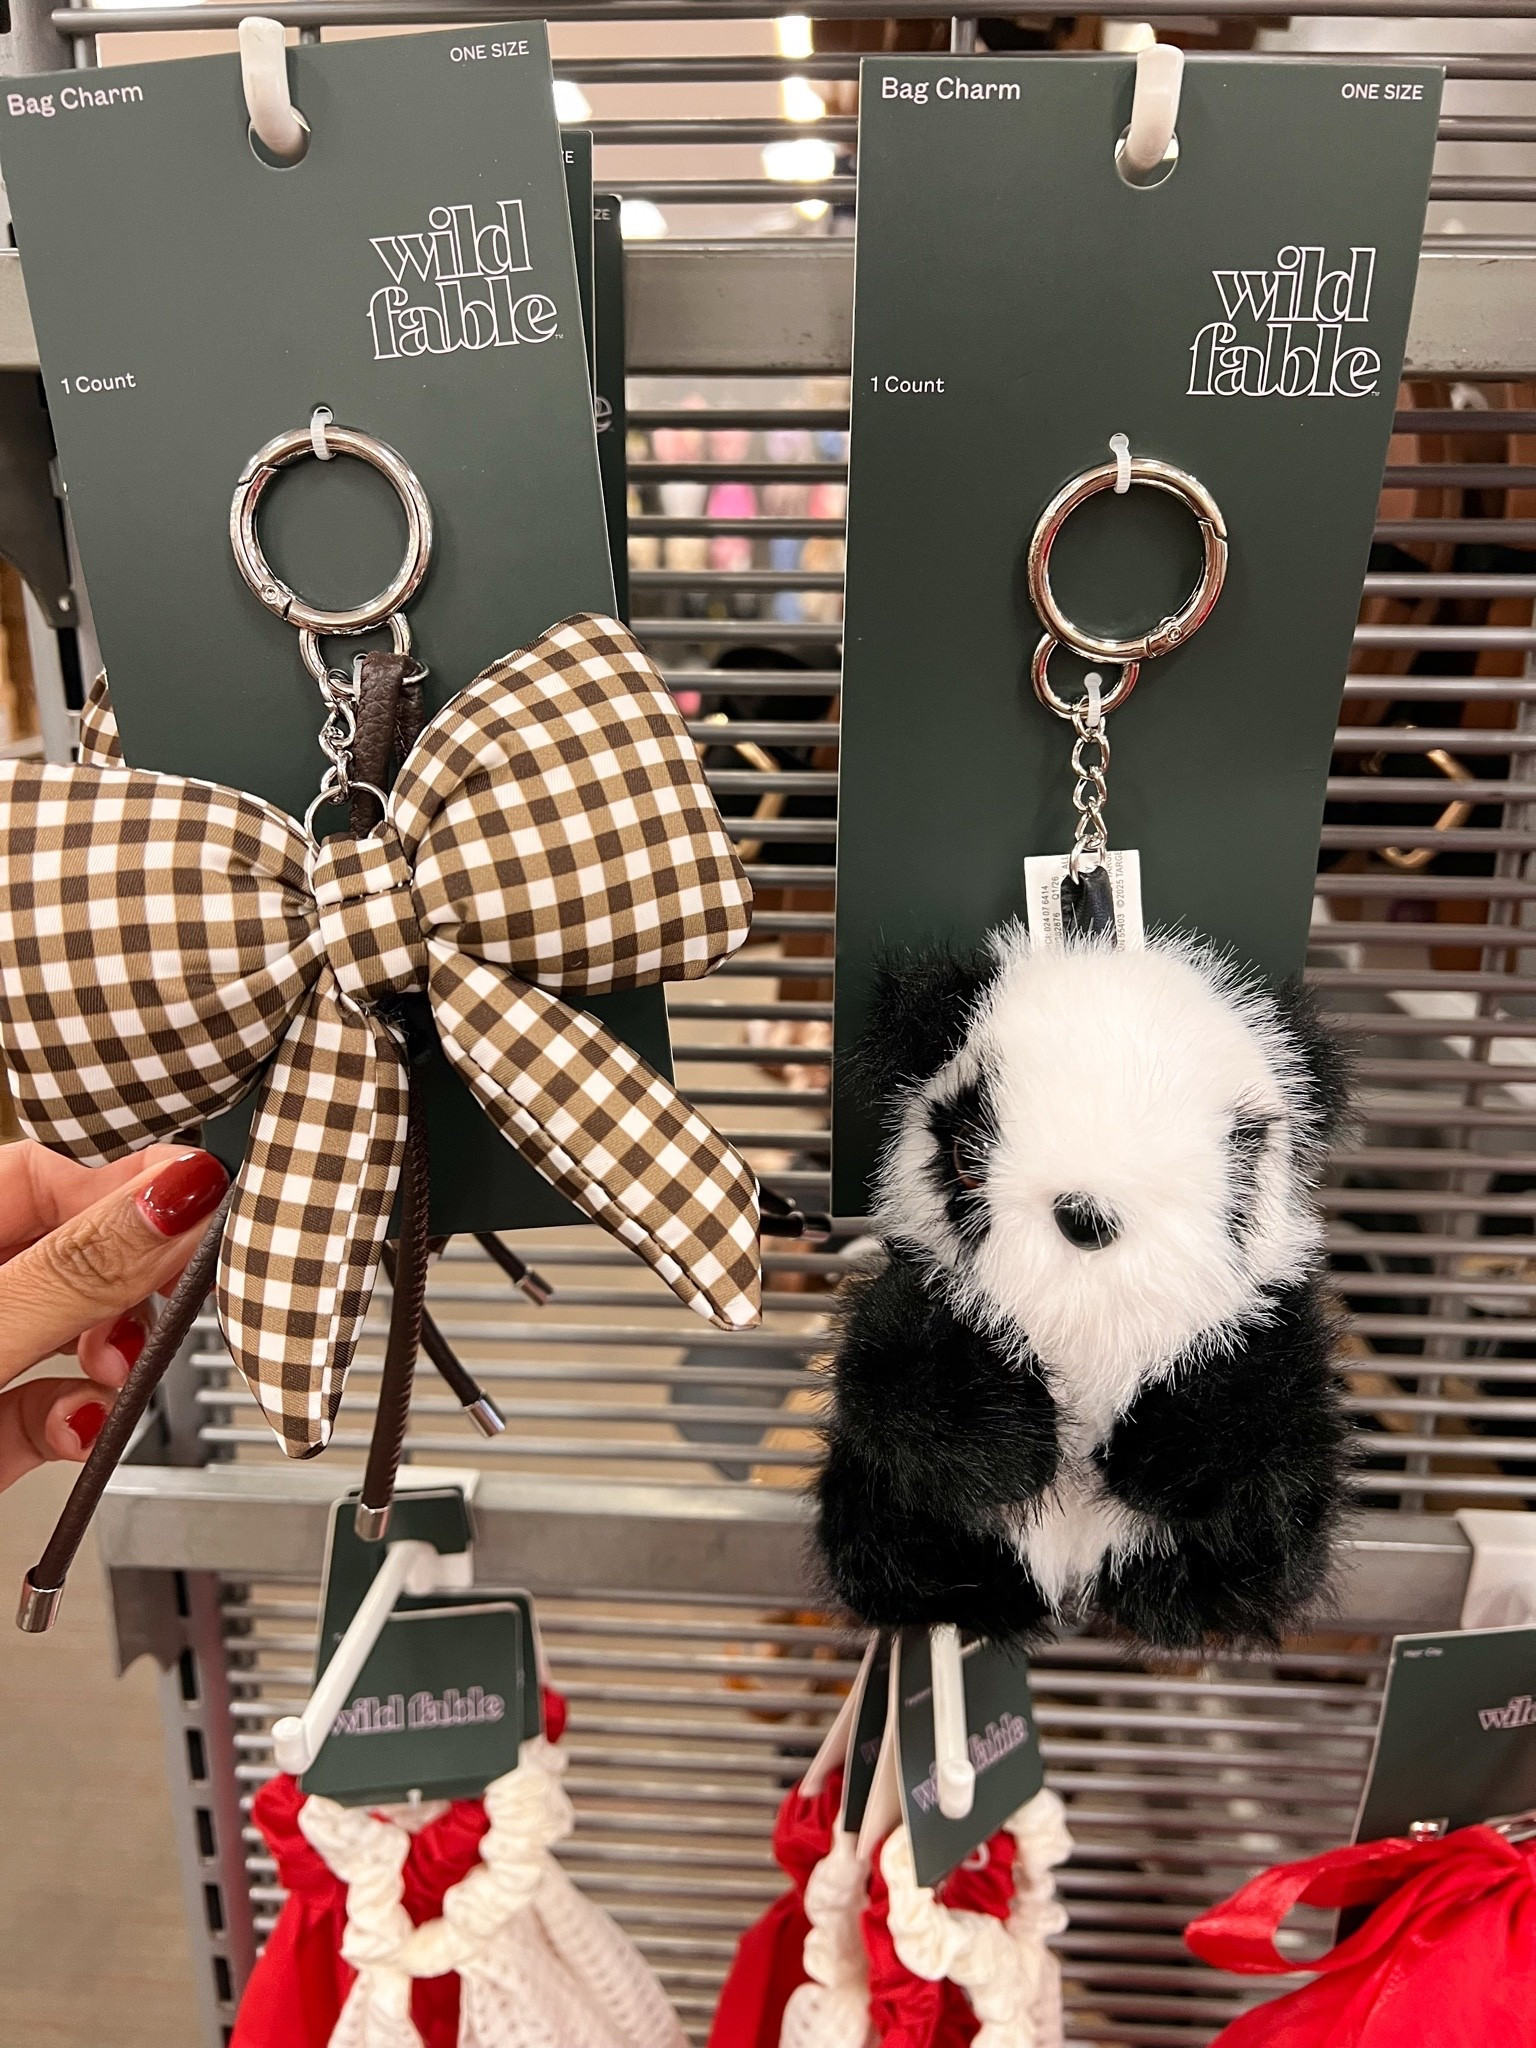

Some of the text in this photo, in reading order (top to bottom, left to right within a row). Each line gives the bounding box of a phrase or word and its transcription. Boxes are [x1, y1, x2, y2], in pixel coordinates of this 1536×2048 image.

[449, 40, 530, 62] ONE SIZE
[7, 83, 144, 119] Bag Charm
[881, 76, 1021, 104] Bag Charm
[1341, 83, 1424, 100] ONE SIZE
[369, 199, 533, 285] wild
[1212, 244, 1376, 322] wild
[366, 275, 558, 361] fable
[1186, 321, 1381, 398] fable
[60, 371, 137, 395] 1 Count
[870, 375, 945, 394] 1 Count
